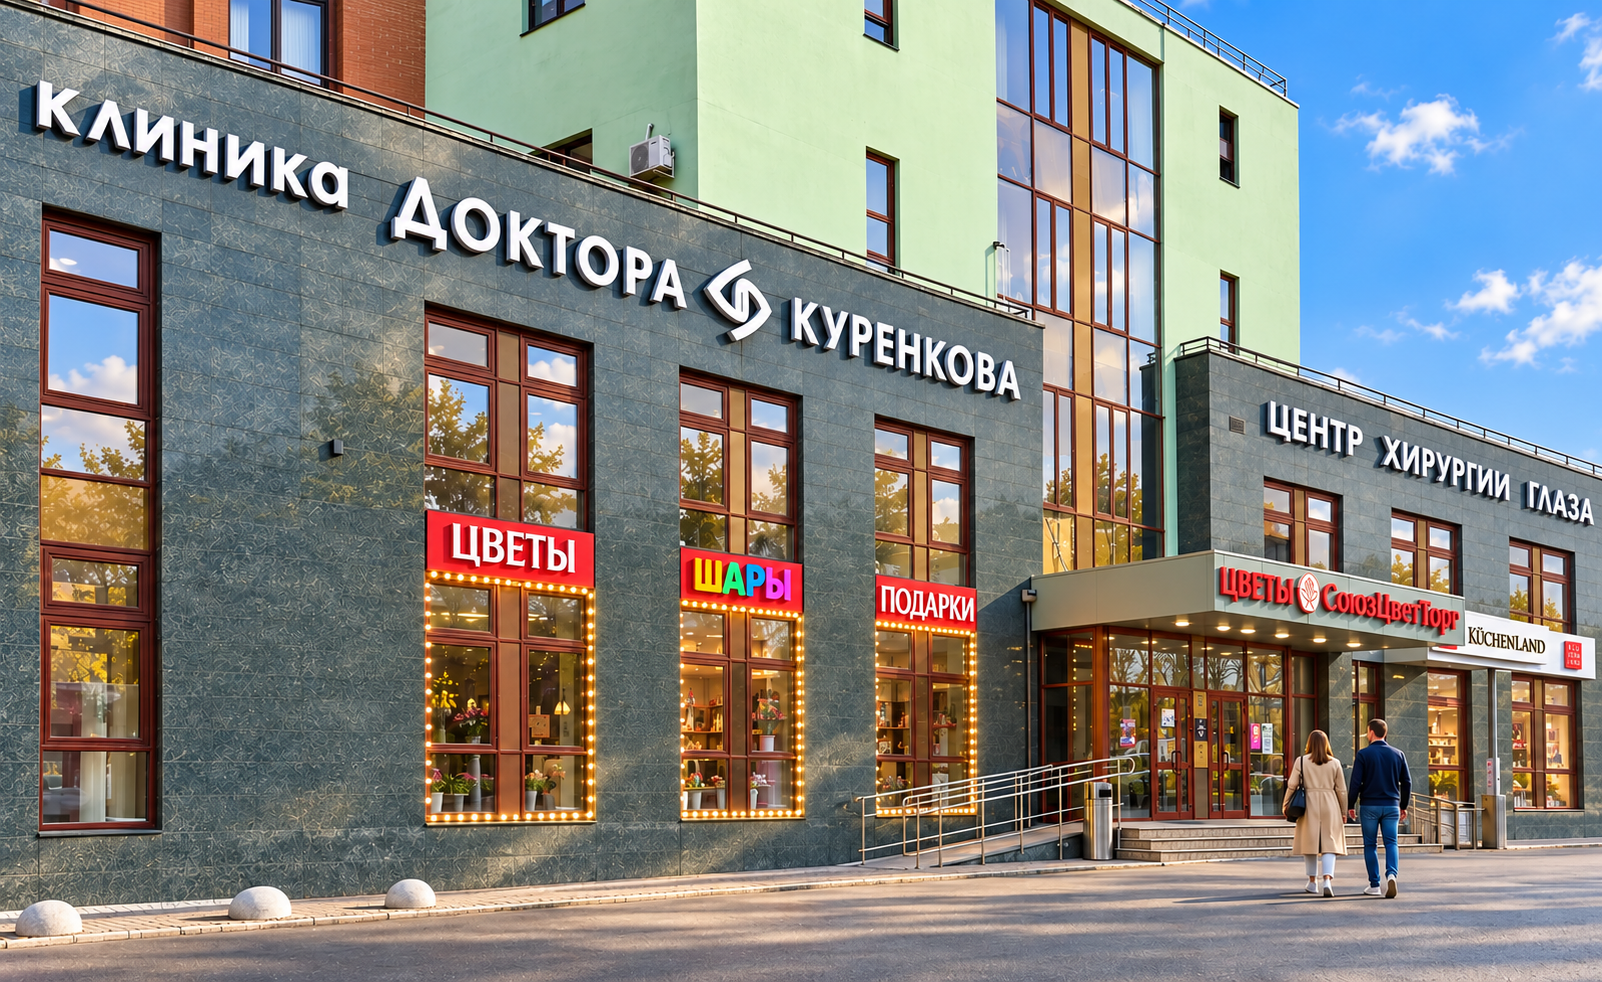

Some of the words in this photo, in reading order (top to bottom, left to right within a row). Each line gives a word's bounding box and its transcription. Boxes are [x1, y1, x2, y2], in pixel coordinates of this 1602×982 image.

[390, 176, 687, 310] ДОКТОРА
[791, 297, 1021, 400] КУРЕНКОВА
[1266, 400, 1363, 457] ЦЕНТР
[1380, 435, 1510, 502] ХИРУРГИИ
[1525, 481, 1594, 526] ГЛАЗА
[452, 522, 576, 574] ЦВЕТЫ
[694, 557, 792, 601] ШАРЫ
[881, 585, 975, 622] ПОДАРКИ
[1219, 566, 1294, 605] ЦВЕТЫ
[1321, 583, 1460, 635] СоюзЦветТорг
